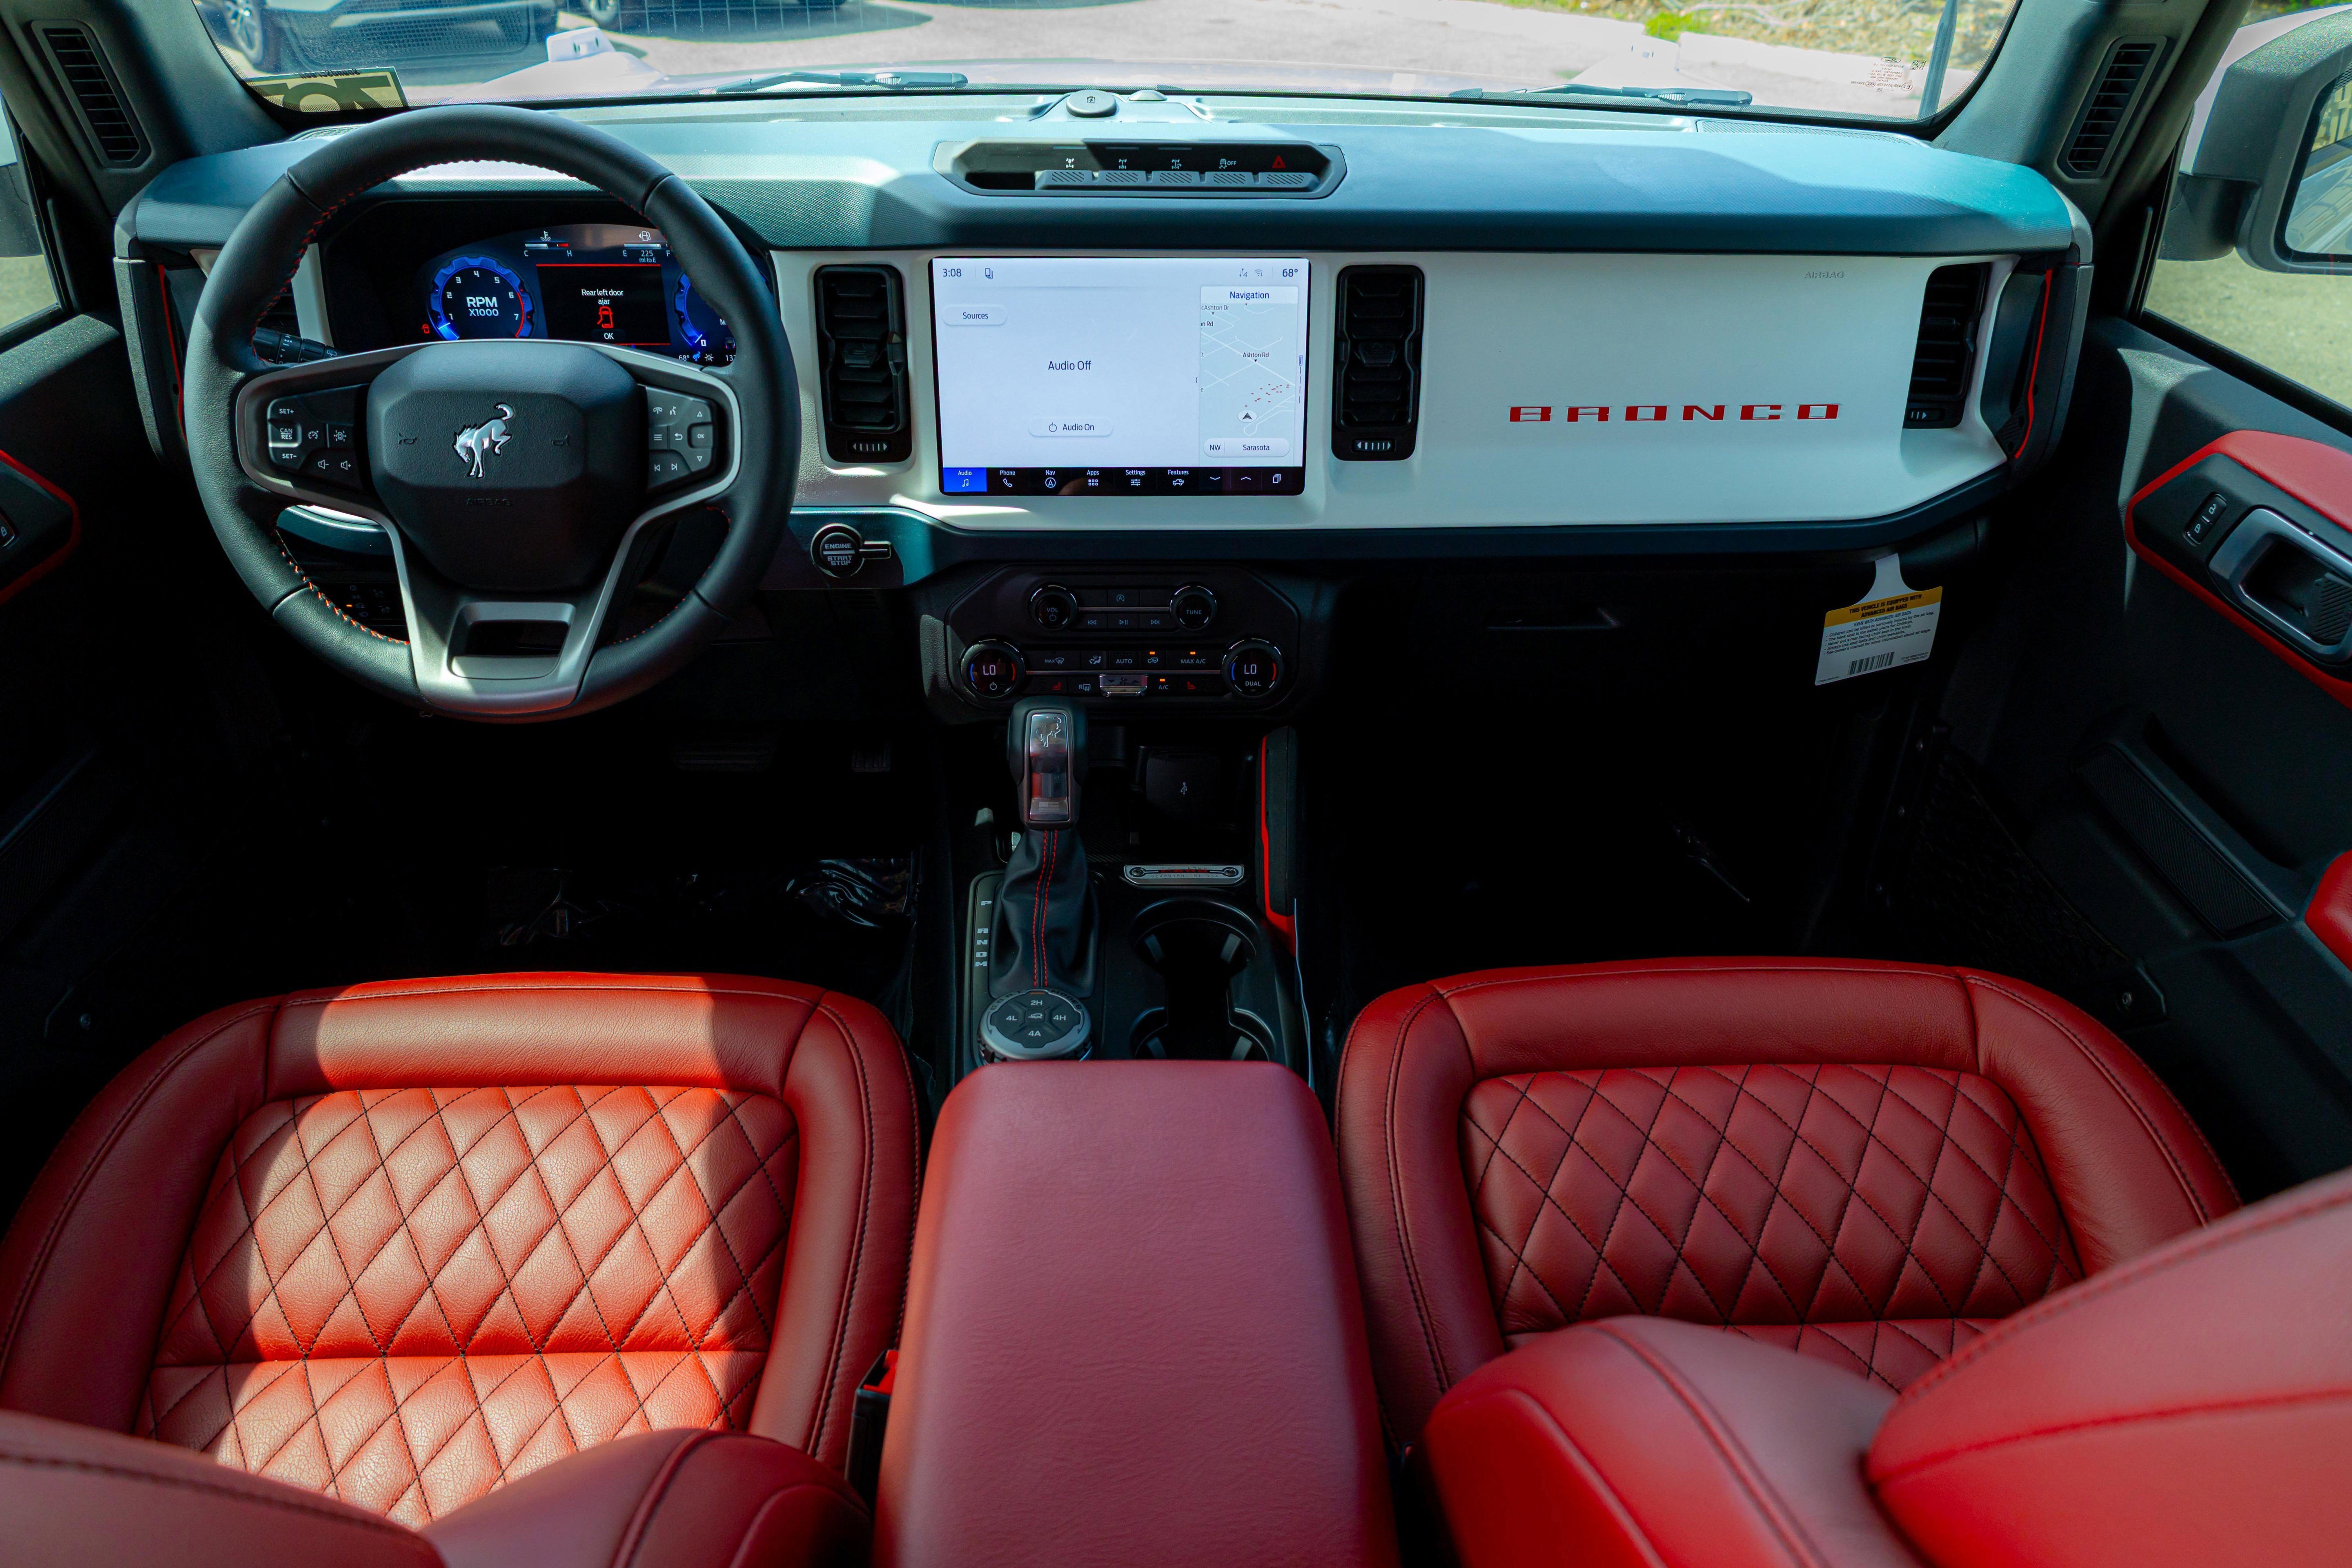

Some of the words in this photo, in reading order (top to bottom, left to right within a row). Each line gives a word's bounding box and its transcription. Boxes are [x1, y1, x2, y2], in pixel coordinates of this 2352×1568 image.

[942, 268, 962, 277] 3:08
[1282, 269, 1298, 277] 68°
[1230, 291, 1270, 300] Navigation
[466, 296, 498, 307] RPM
[1048, 361, 1075, 370] Audio
[1077, 361, 1092, 370] Off
[1509, 404, 1839, 422] BRONCO
[1861, 603, 1880, 611] VEHICLE
[1886, 597, 1909, 606] EQUIPPED
[1861, 608, 1886, 618] ADVANCED
[983, 665, 996, 675] LO
[1244, 664, 1257, 675] LO
[1051, 989, 1082, 1010] MODES
